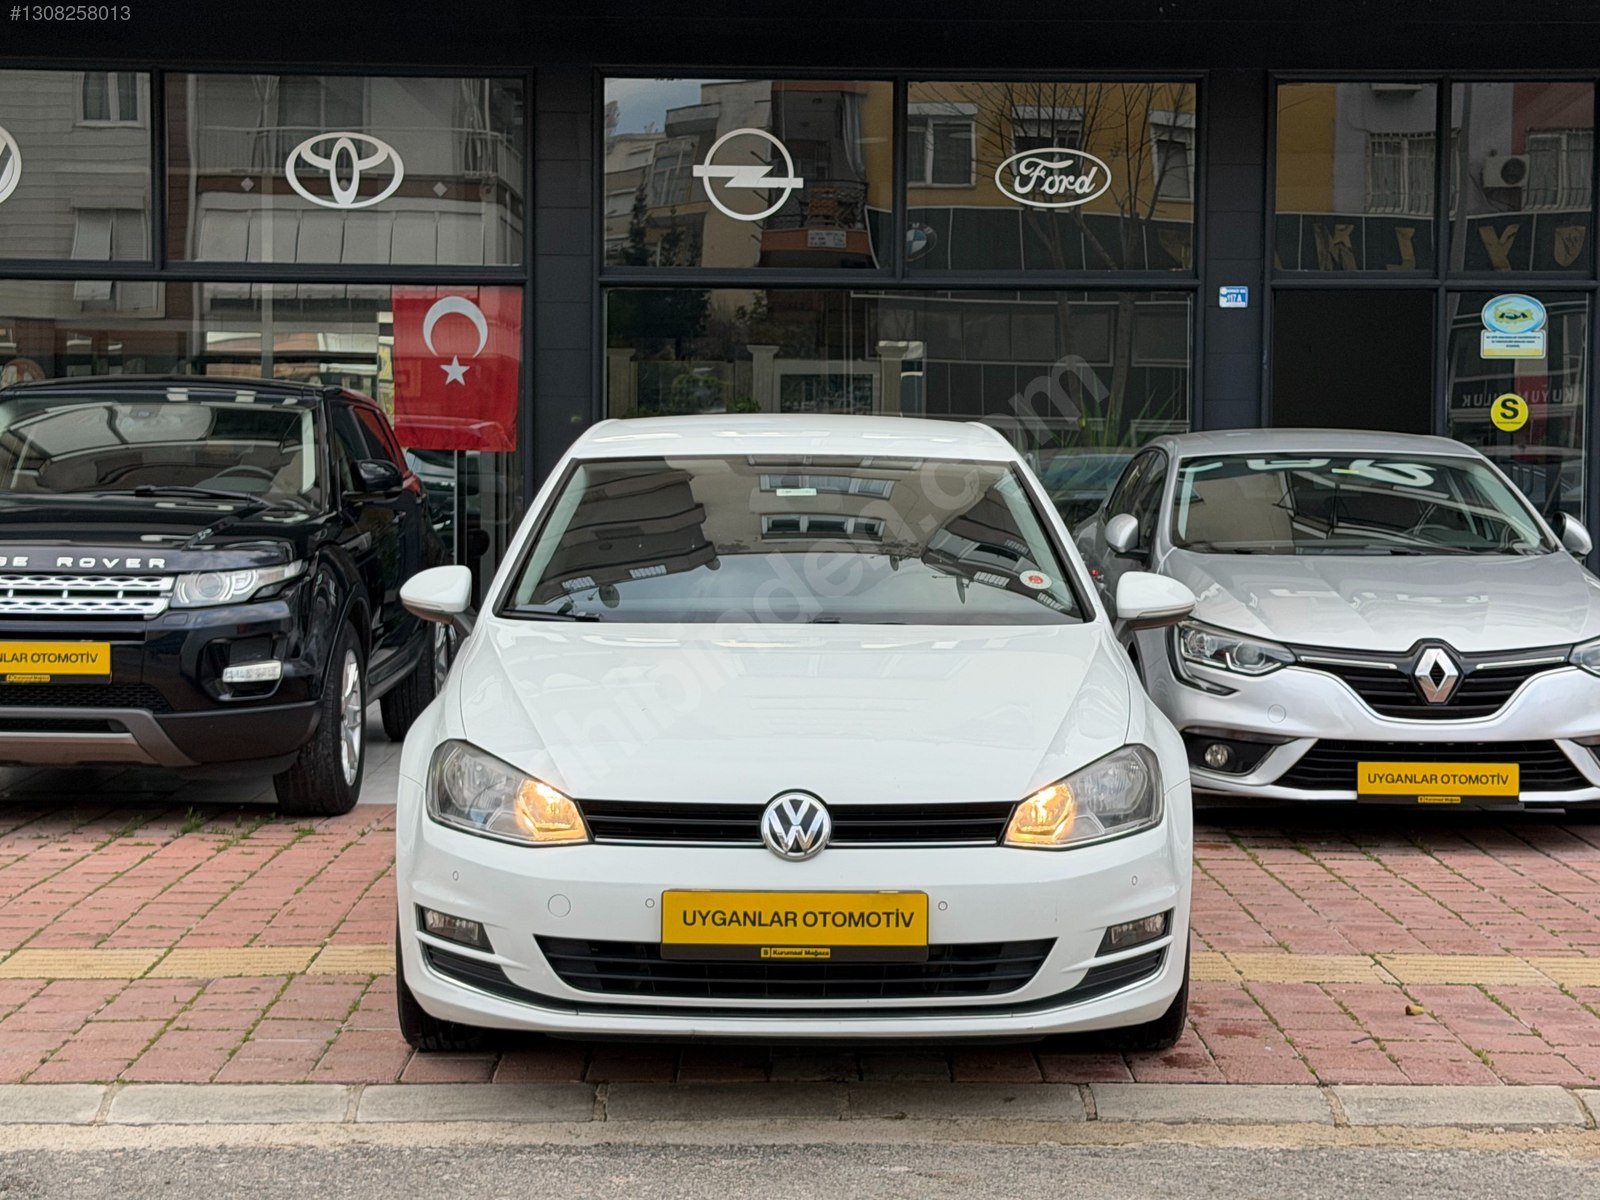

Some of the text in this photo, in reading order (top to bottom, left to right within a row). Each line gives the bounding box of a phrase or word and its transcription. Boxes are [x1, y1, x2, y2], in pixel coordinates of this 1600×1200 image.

[1014, 157, 1098, 194] Ford
[1500, 398, 1519, 420] S
[56, 556, 166, 569] ROVER
[30, 651, 99, 664] OTOMOTİV
[1367, 772, 1510, 786] UYGANLAR OTOMOTİV
[682, 908, 915, 929] UYGANLAR OTOMOTİV
